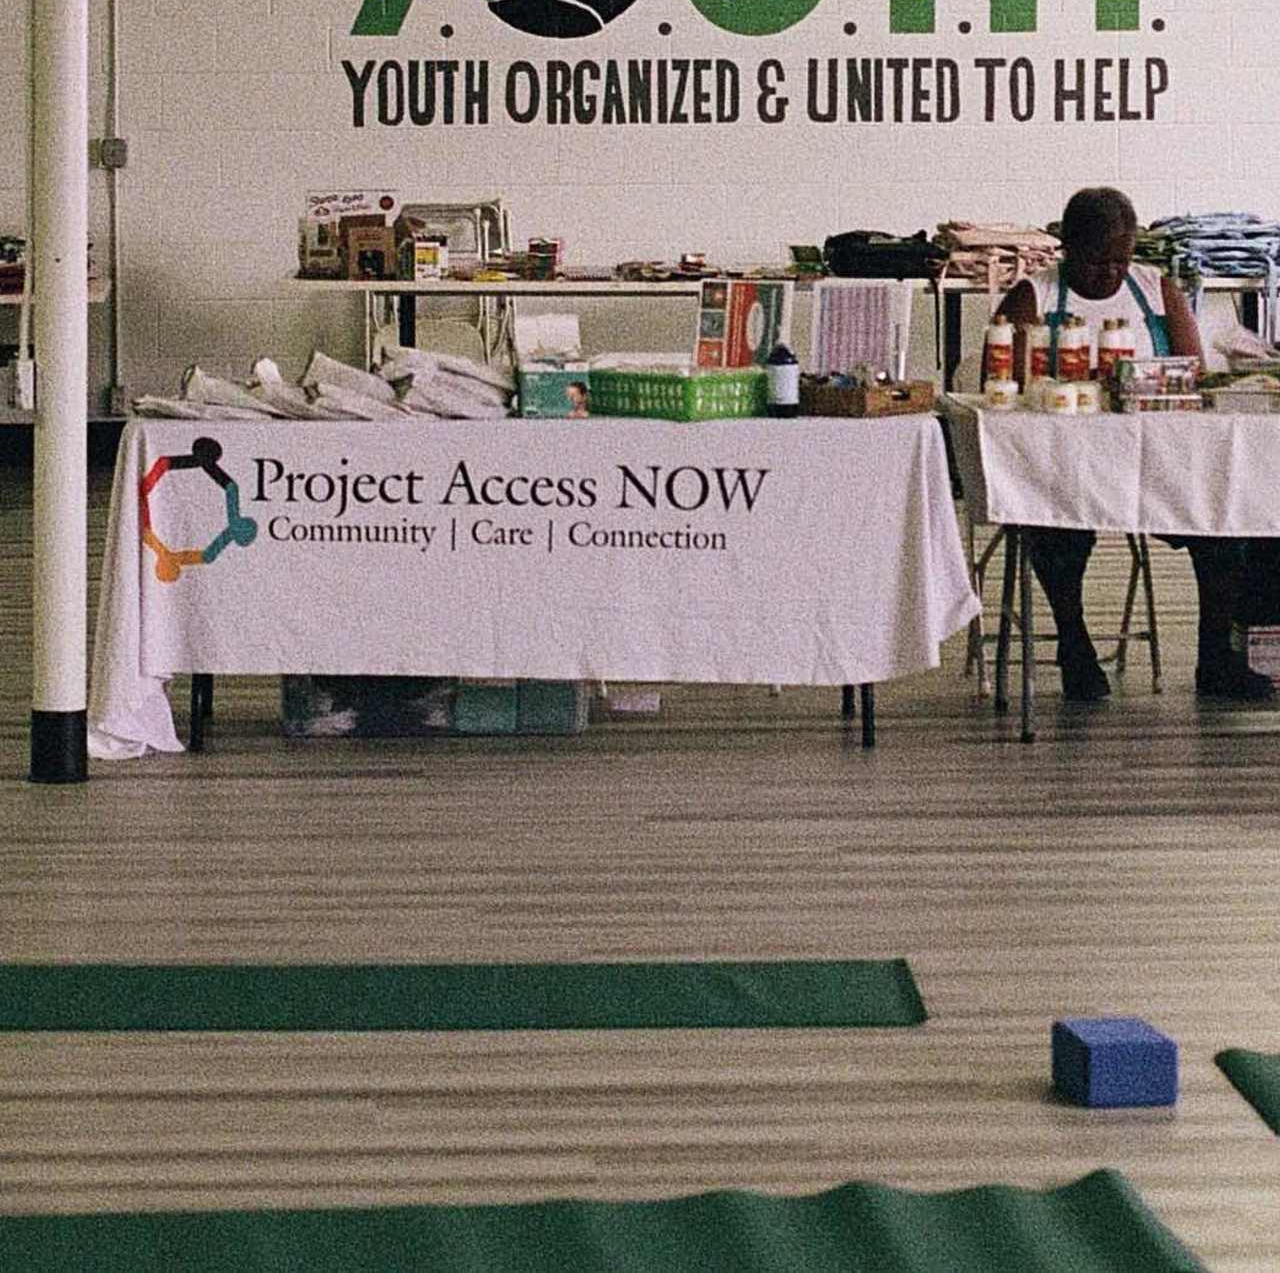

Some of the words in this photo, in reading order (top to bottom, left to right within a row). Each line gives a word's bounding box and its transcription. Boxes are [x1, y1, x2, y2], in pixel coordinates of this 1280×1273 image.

[341, 59, 489, 128] YOUTH
[505, 58, 739, 125] ORGANIZED
[757, 58, 790, 124] &
[807, 57, 961, 124] UNITED
[974, 56, 1036, 123] TO
[1054, 56, 1169, 123] HELP
[251, 457, 424, 519] Project
[439, 460, 597, 508] Access
[617, 464, 771, 513] NOW
[268, 515, 437, 553] Community
[470, 520, 534, 547] Care
[567, 521, 728, 551] Connection
